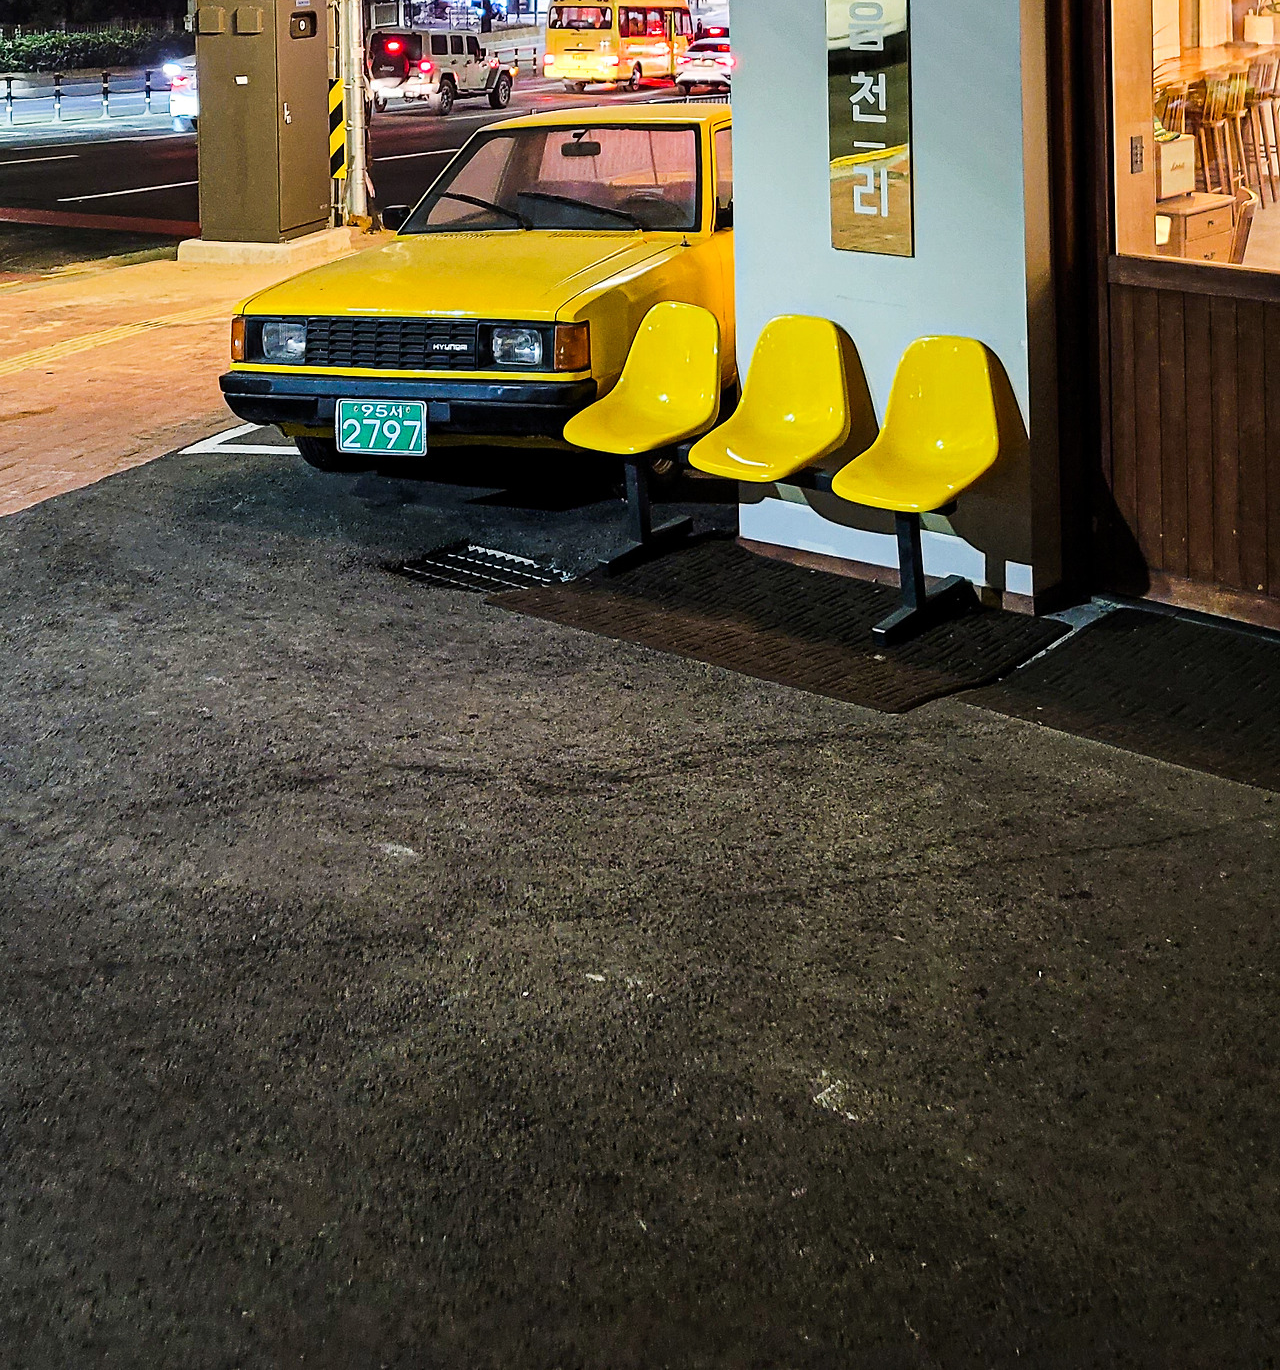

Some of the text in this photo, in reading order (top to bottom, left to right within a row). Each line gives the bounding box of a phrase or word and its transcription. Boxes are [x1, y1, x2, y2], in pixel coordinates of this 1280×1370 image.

[432, 343, 468, 351] HYUNDAI
[361, 404, 403, 419] 95서
[342, 418, 422, 450] 2797
